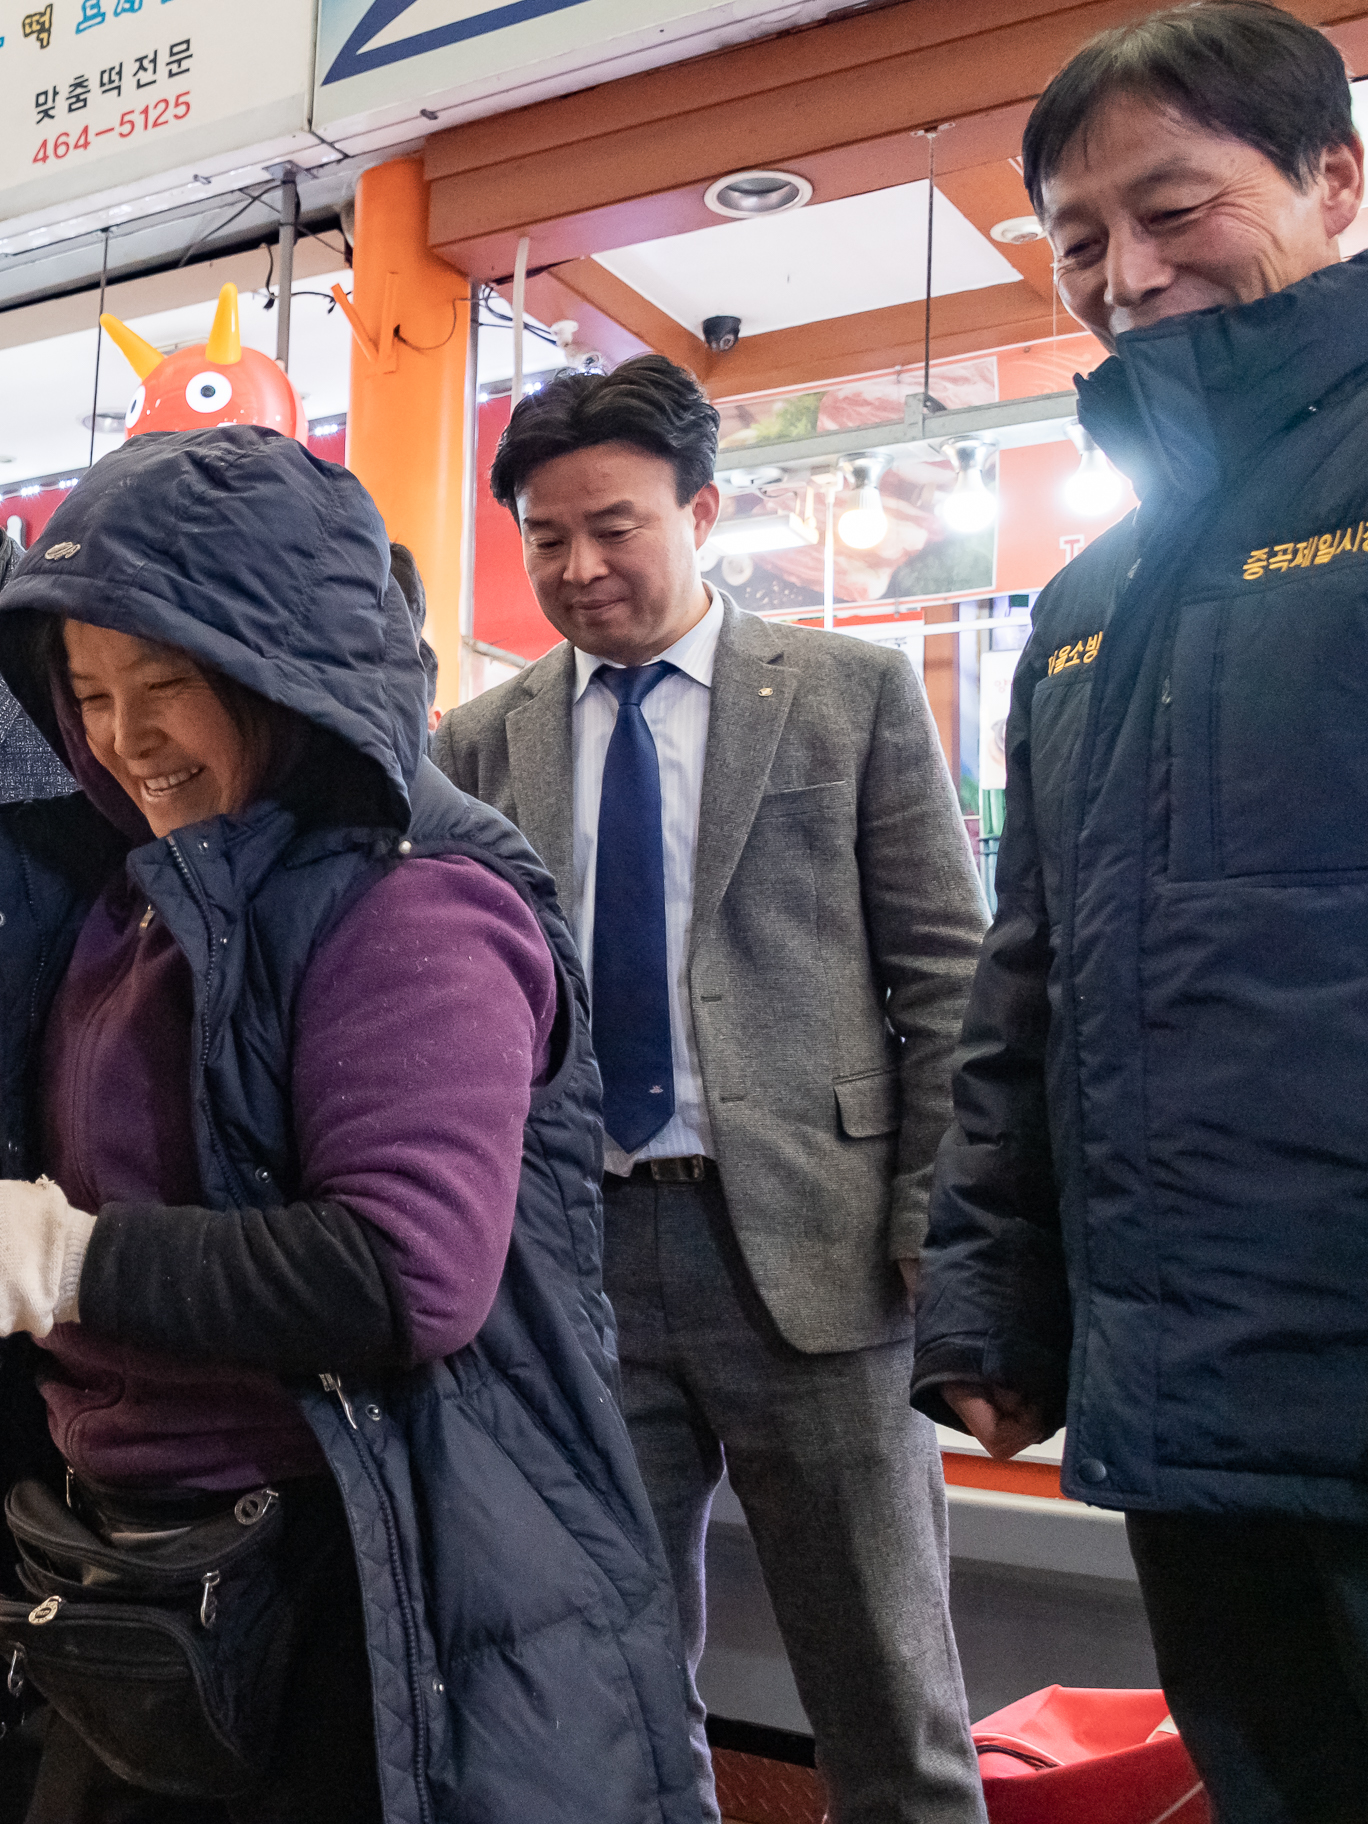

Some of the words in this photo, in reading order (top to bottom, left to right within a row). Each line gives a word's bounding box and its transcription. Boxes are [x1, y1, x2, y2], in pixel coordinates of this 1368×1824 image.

[22, 3, 54, 50] 떡
[34, 38, 193, 125] 맞춤떡전문
[32, 90, 191, 165] 464-5125
